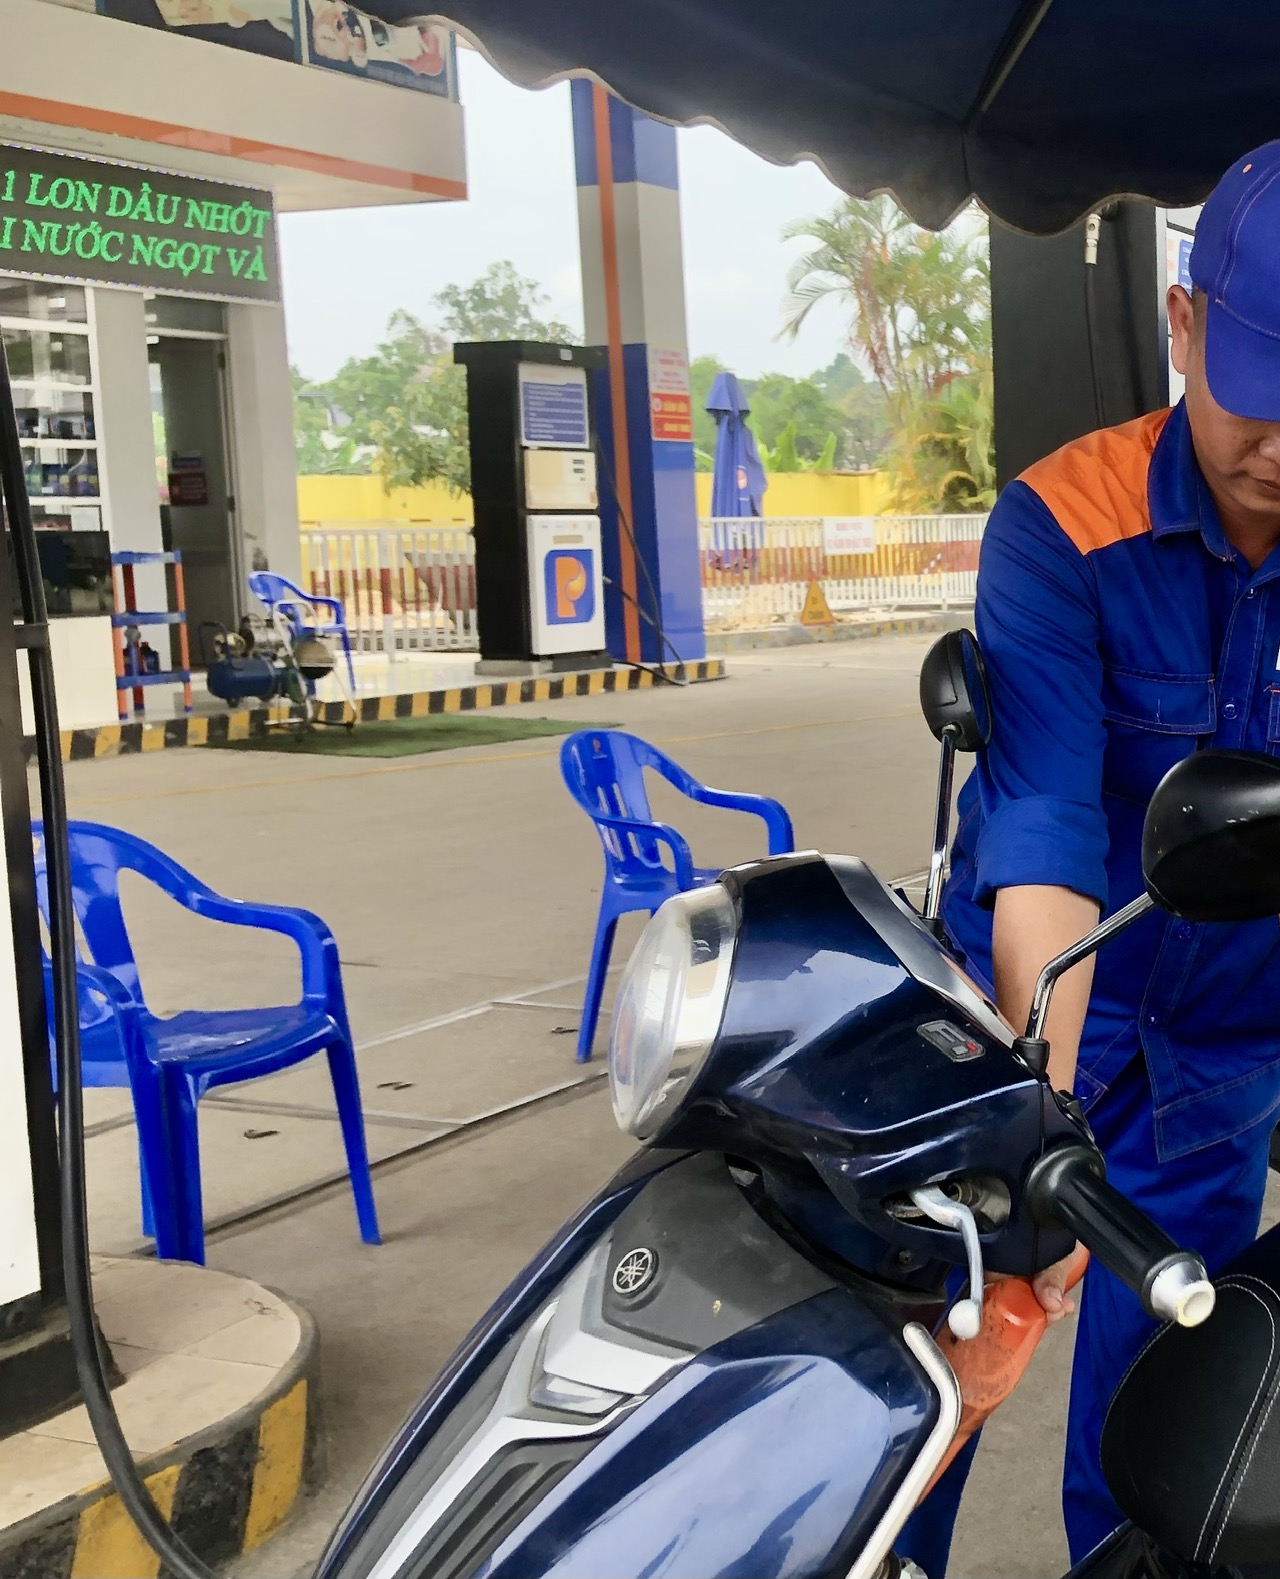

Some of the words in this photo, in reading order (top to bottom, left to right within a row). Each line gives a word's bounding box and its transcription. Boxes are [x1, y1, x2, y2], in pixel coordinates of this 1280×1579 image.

[1, 170, 15, 202] 1
[25, 173, 102, 213] LON
[106, 182, 181, 225] DẦU
[184, 201, 271, 239] NHỚT
[20, 219, 125, 263] NƯỚC
[128, 234, 221, 277] NGỌT
[227, 245, 269, 282] VÀ
